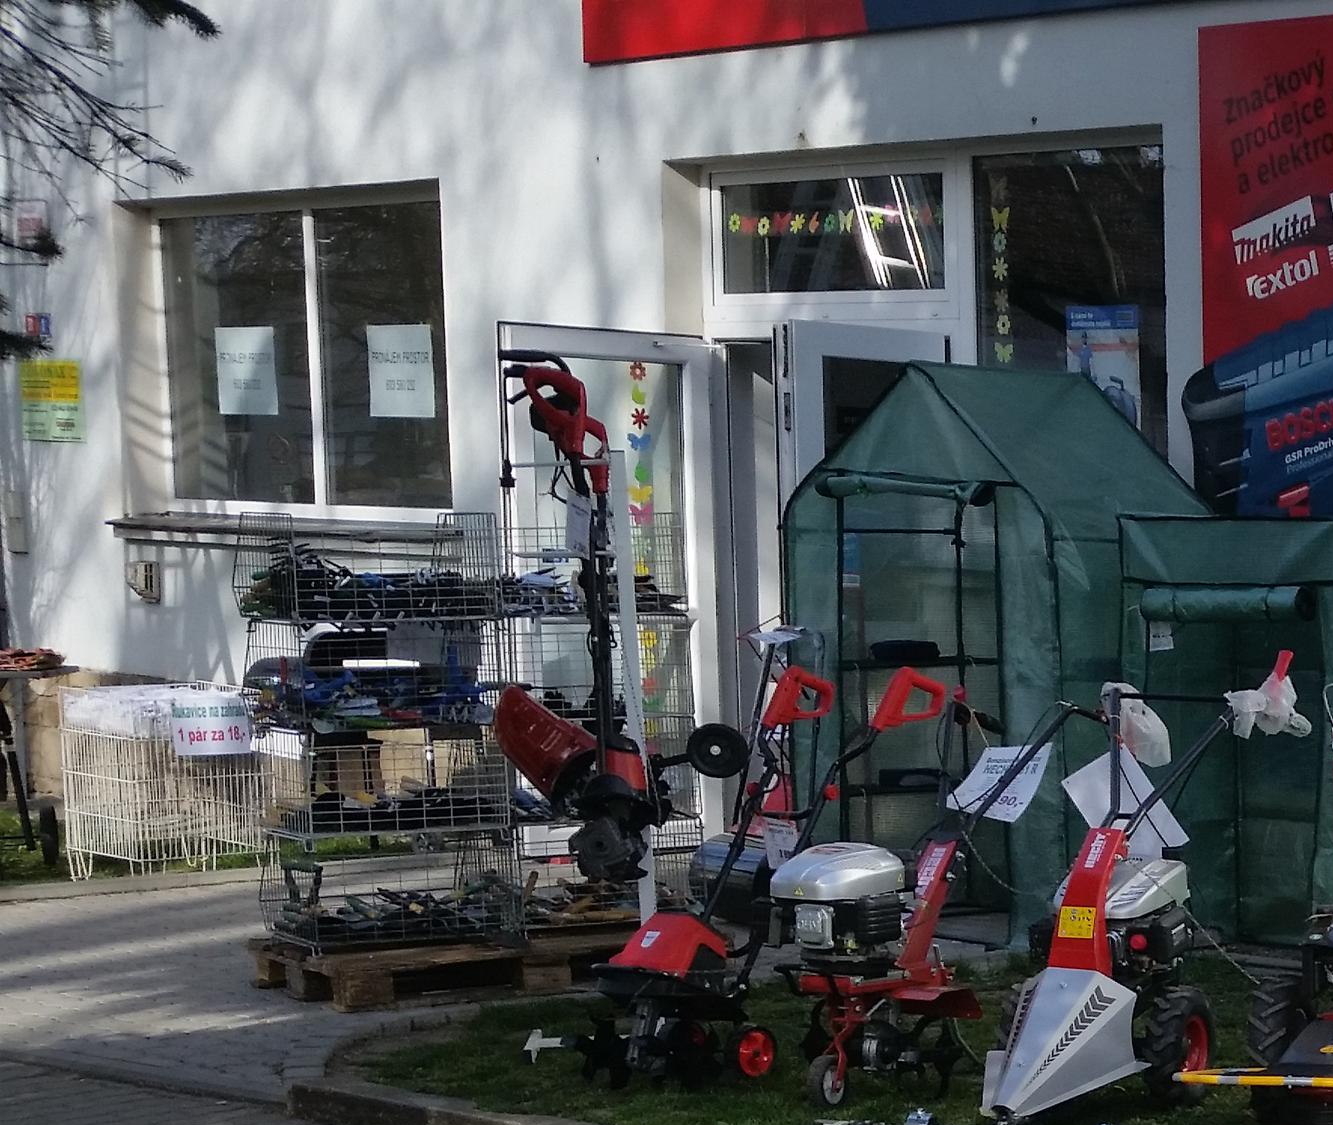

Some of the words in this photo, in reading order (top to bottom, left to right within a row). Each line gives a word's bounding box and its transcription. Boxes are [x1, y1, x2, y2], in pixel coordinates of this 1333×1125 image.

[1222, 52, 1326, 125] Značkový
[1231, 97, 1327, 166] prodejce
[1238, 174, 1251, 194] a
[178, 727, 184, 742] 1
[188, 726, 207, 745] pár
[211, 730, 225, 741] za
